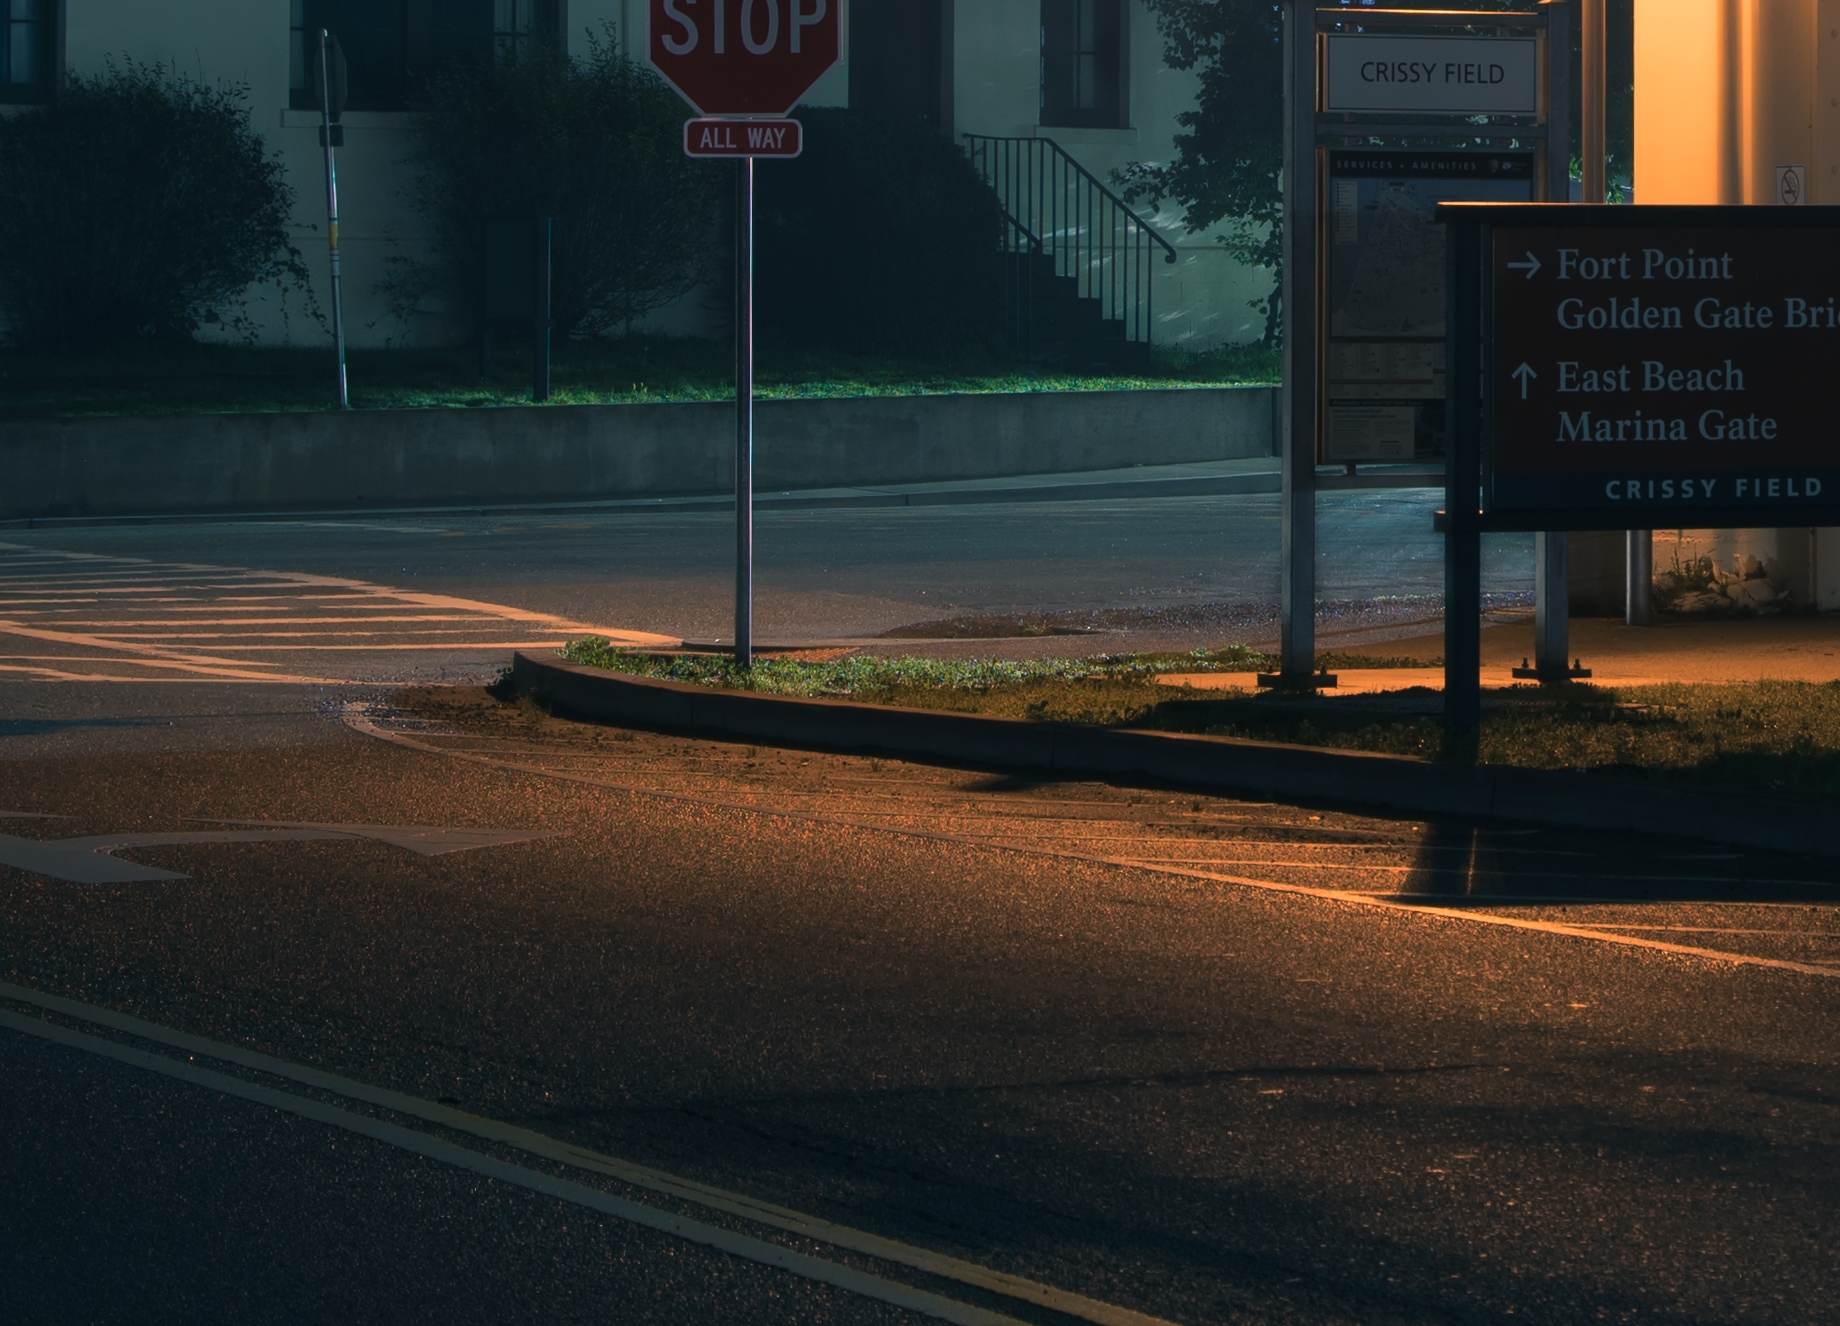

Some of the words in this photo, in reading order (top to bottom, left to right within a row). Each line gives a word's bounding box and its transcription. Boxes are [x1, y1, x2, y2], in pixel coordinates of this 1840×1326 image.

[1361, 61, 1437, 84] CRISSY
[1445, 62, 1505, 85] FIELD
[700, 128, 737, 149] ALL
[748, 128, 787, 149] WAY
[1336, 160, 1393, 169] SERVICES
[1411, 161, 1477, 170] AMENITIES
[1557, 249, 1632, 280] Fort
[1642, 249, 1733, 280] Point
[1557, 297, 1682, 330] Golden
[1694, 299, 1773, 330] Gate
[1557, 361, 1631, 393] East
[1642, 360, 1745, 393] Beach
[1557, 411, 1687, 442] Marina
[1698, 409, 1778, 441] Gate
[1606, 478, 1716, 500] CRISSY
[1736, 477, 1823, 498] FIELD
